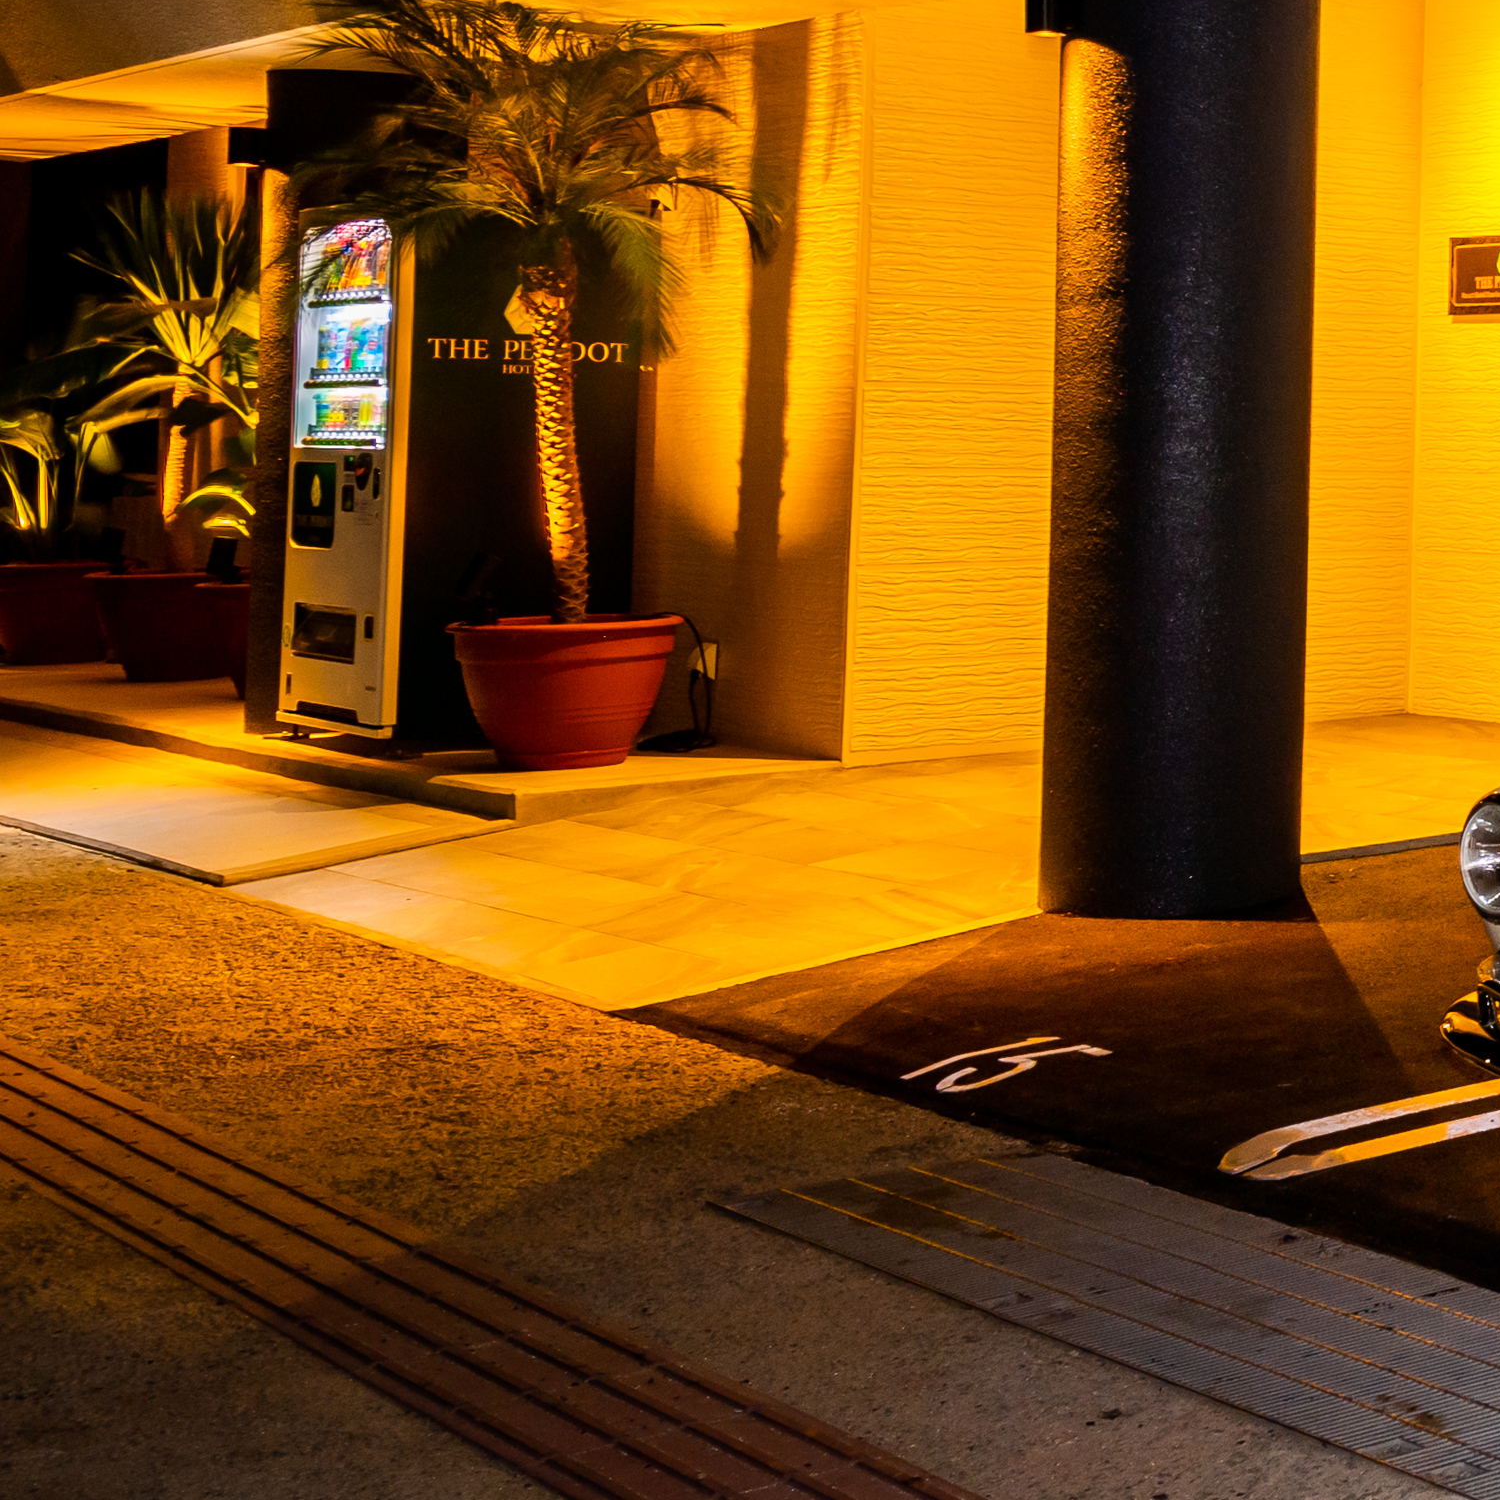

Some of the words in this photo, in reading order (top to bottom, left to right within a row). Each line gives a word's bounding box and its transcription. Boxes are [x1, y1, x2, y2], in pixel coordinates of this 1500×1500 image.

[427, 337, 489, 360] THE
[503, 339, 629, 363] PEDOT
[900, 1036, 1113, 1092] 15
